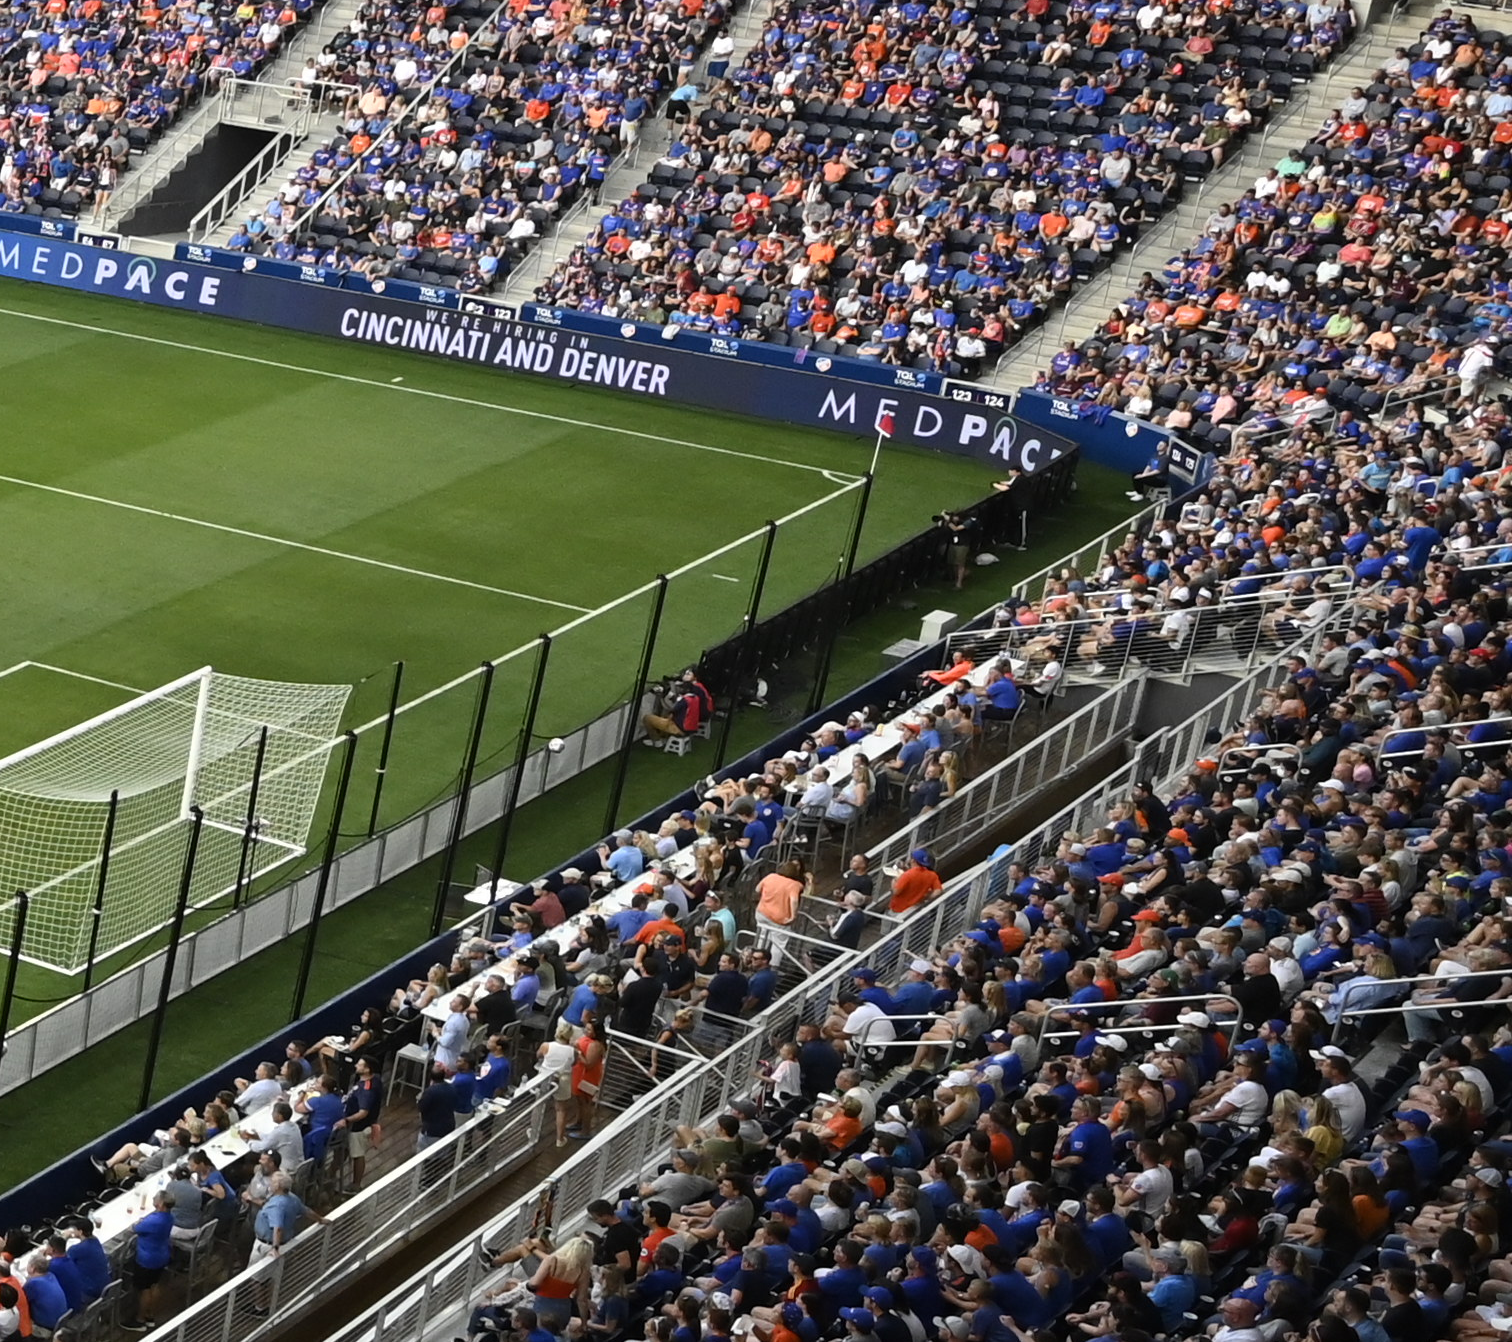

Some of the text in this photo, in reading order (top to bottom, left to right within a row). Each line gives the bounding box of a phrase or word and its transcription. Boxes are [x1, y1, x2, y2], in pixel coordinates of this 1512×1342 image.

[494, 307, 512, 320] 123
[425, 309, 589, 348] WE'RE HIRING IN
[340, 307, 671, 396] CINCINNATI AND DENVER
[711, 338, 729, 349] TQL
[894, 377, 926, 389] STADIUM
[896, 370, 914, 382] TQL
[951, 389, 1004, 408] 123 124
[818, 389, 1062, 471] MEDPAC
